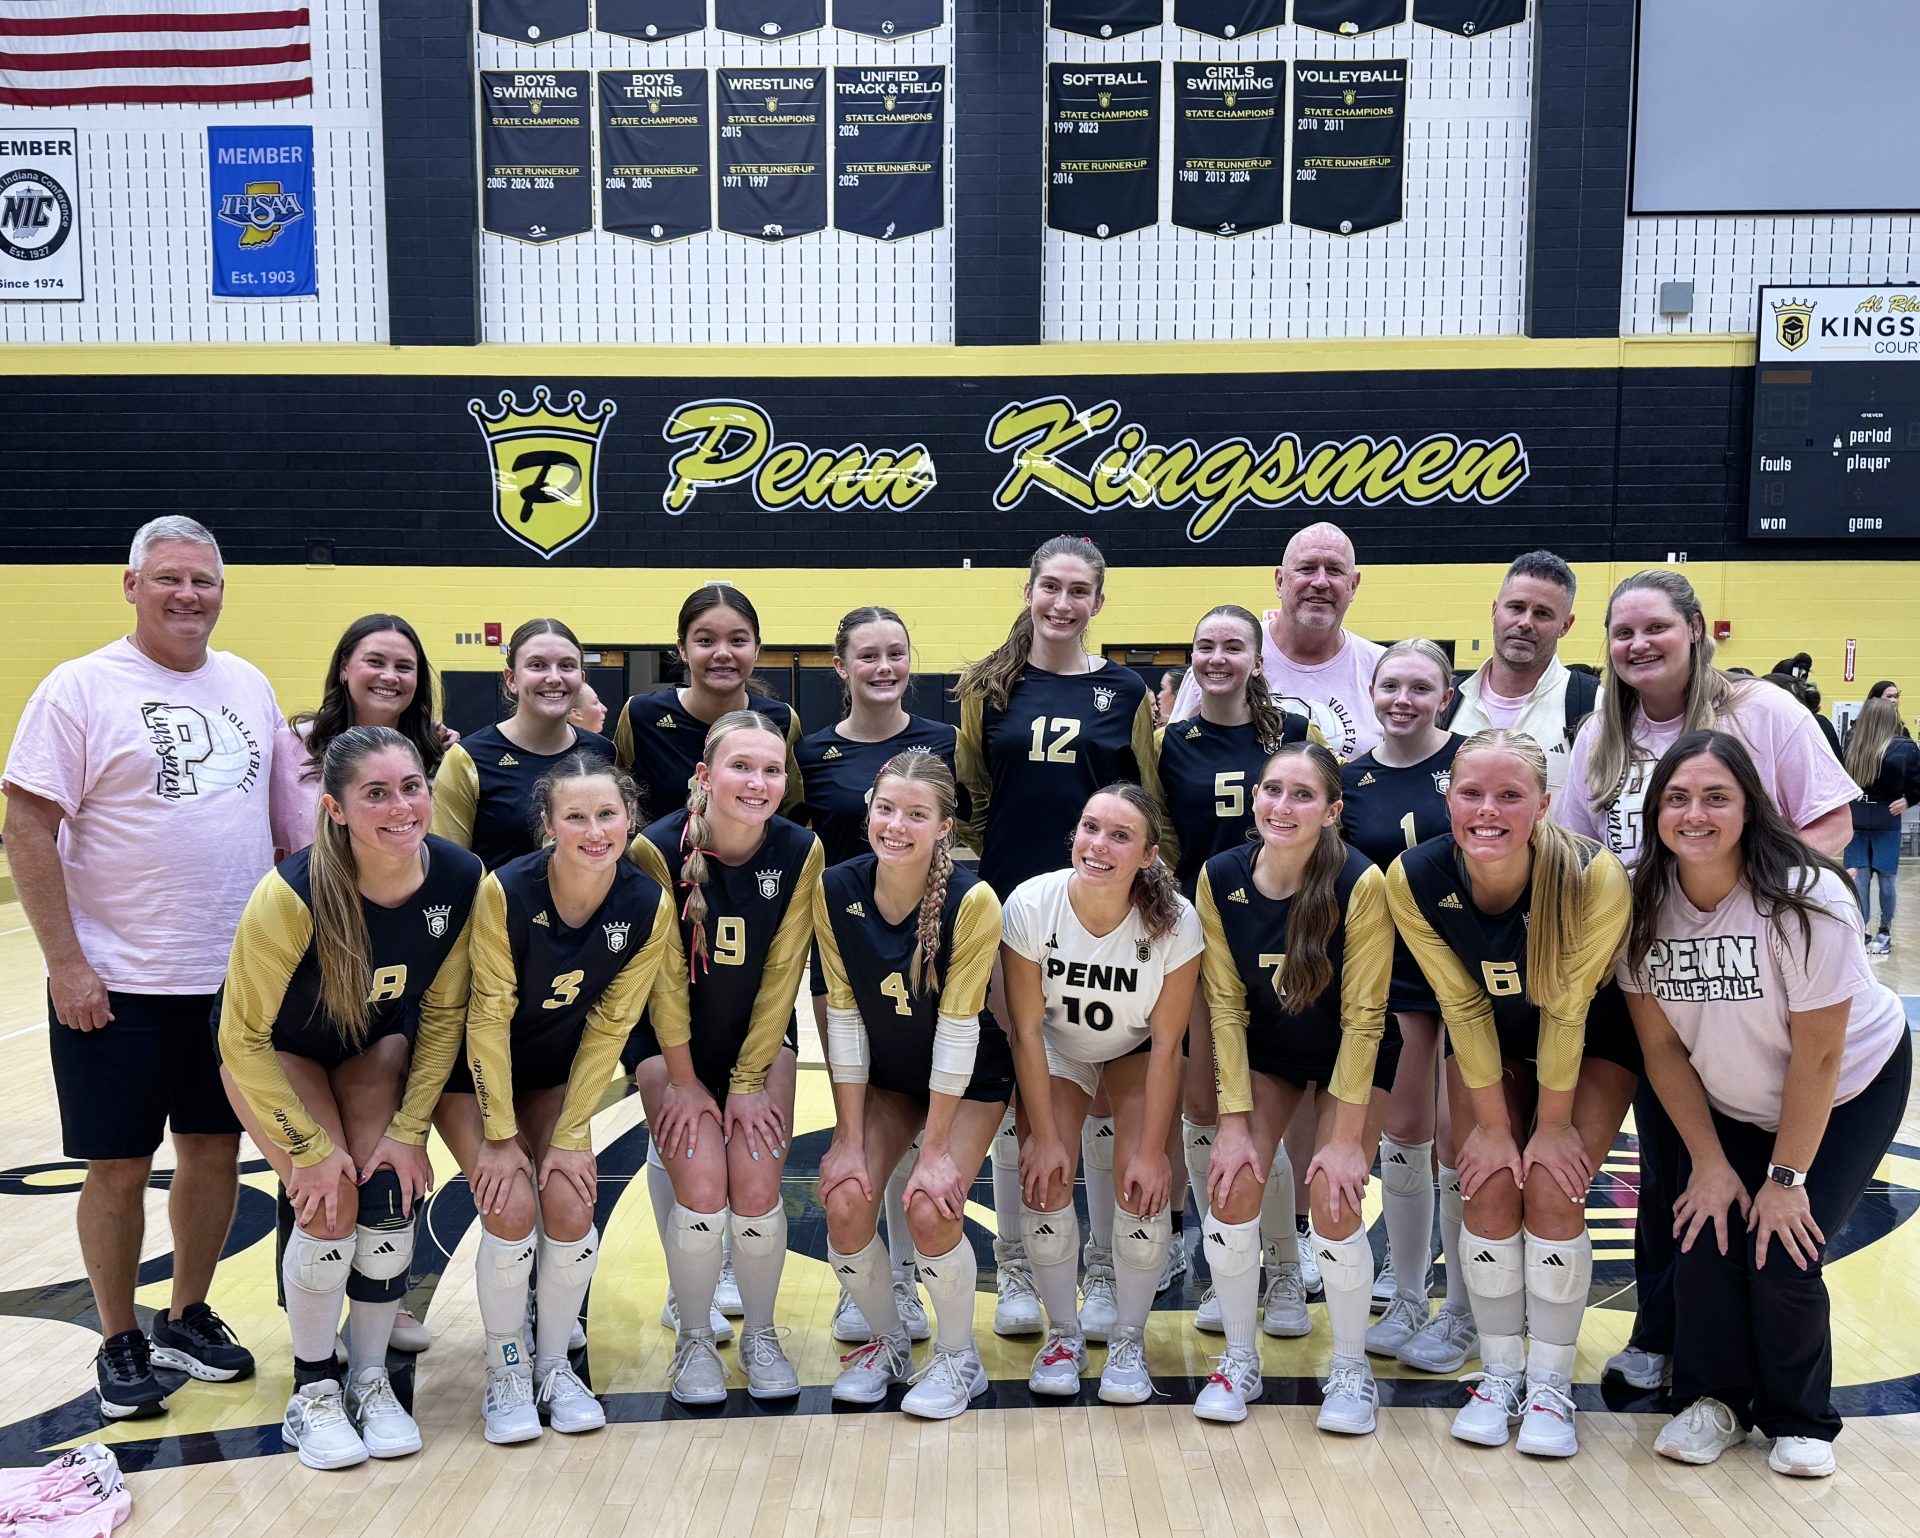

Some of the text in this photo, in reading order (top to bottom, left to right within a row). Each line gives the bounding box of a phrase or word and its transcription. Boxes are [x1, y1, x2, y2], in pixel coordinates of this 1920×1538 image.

[861, 71, 919, 82] UNIFIED
[1205, 66, 1254, 78] GIRLS
[1297, 69, 1403, 83] VOLLEYBALL
[514, 75, 556, 86] BOYS
[632, 74, 674, 86] BOYS
[728, 78, 814, 90] WRESTLING
[1062, 73, 1148, 86] SOFTBALL
[1187, 78, 1274, 90] SWIMMING
[493, 87, 578, 98] SWIMMING
[624, 86, 683, 98] TENNIS
[836, 82, 942, 94] TRACK & FIELD
[845, 113, 933, 122] STATE CHAMPIONS
[1060, 109, 1149, 119] STATE CHAMPIONS
[1185, 109, 1274, 118] STATE CHAMPIONS
[1304, 107, 1394, 116] STATE CHAMPIONS
[523, 117, 580, 125] CHAMPIONS
[610, 116, 698, 125] STATE CHAMPIONS
[727, 114, 816, 123] STATE CHAMPIONS
[1298, 118, 1344, 131] 2010 2011
[721, 126, 742, 137] 2015
[838, 125, 859, 136] 2026
[1053, 122, 1099, 134] 1999 2023
[0, 140, 72, 156] EMBER
[218, 147, 303, 165] MEMBER
[845, 163, 932, 173] STATE RUNNER-UP
[1060, 160, 1147, 170] STATE RUNNER-UP
[1186, 160, 1272, 168] STATE RUNNER-UP
[1304, 158, 1391, 167] STATE RUNNER-UP
[524, 168, 580, 176] RUNNER-UP
[613, 167, 698, 175] STATE RUNNER-UP
[729, 165, 815, 174] STATE RUNNER-UP
[1296, 169, 1317, 181] 2002
[722, 176, 769, 188] 1971 1997
[838, 175, 859, 186] 2025
[1053, 173, 1073, 184] 2016
[1179, 170, 1250, 183] 1980 2013 2024
[487, 177, 554, 189] 2005 2024 2026
[605, 177, 652, 189] 2004 2005
[3, 172, 70, 228] Indiana Conference
[0, 196, 54, 229] NIC
[221, 193, 301, 224] IHSAA
[9, 246, 50, 259] Est. 1927
[34, 279, 64, 288] 1974
[231, 271, 296, 284] Est. 1903
[1855, 295, 1920, 314] Al Rho
[1821, 317, 1920, 337] KINGS
[1850, 427, 1892, 447] period
[663, 395, 1530, 543] Penn Kingsmen
[1760, 456, 1792, 471] fouls
[1847, 454, 1891, 473] player
[1760, 517, 1786, 530] won
[1849, 517, 1883, 532] game
[1028, 716, 1081, 764] 12
[221, 705, 260, 794] VOLLEYBALL
[1214, 771, 1245, 817] 5
[1400, 812, 1418, 849] 1
[714, 917, 746, 965] 9
[1644, 935, 1760, 980] PENN
[1046, 958, 1138, 993] PENN
[1259, 953, 1287, 996] 7
[1481, 960, 1521, 996] 6
[366, 964, 408, 1002] 8
[542, 969, 584, 1009] 3
[880, 972, 912, 1016] 4
[1062, 995, 1113, 1032] 10
